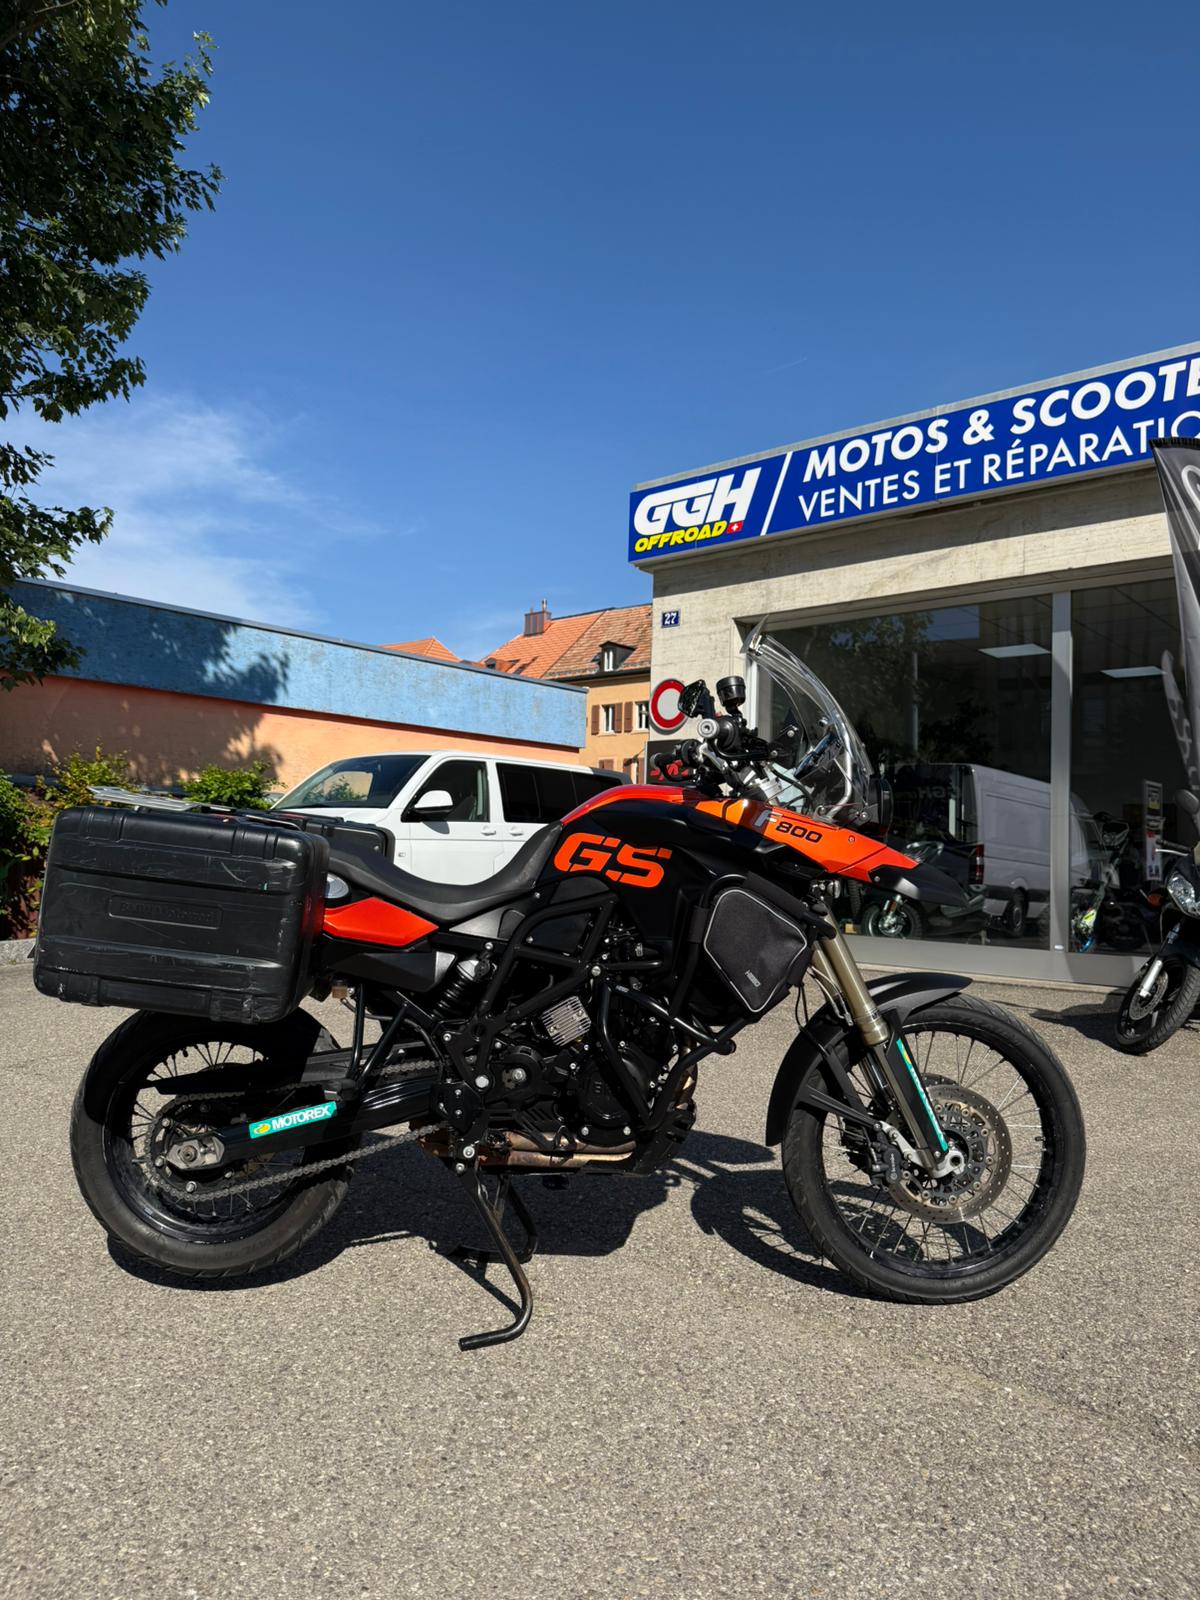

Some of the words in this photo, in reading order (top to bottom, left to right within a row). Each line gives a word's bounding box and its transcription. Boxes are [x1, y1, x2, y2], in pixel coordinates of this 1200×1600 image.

[803, 419, 949, 483] MOTOS
[962, 409, 995, 446] &
[633, 467, 762, 536] GGH
[798, 469, 920, 522] VENTES
[934, 458, 972, 494] ET
[634, 520, 728, 553] OFFROAD
[664, 612, 677, 625] 27
[775, 821, 823, 844] 800
[554, 832, 673, 888] GS
[271, 1105, 332, 1130] MOTOREX
